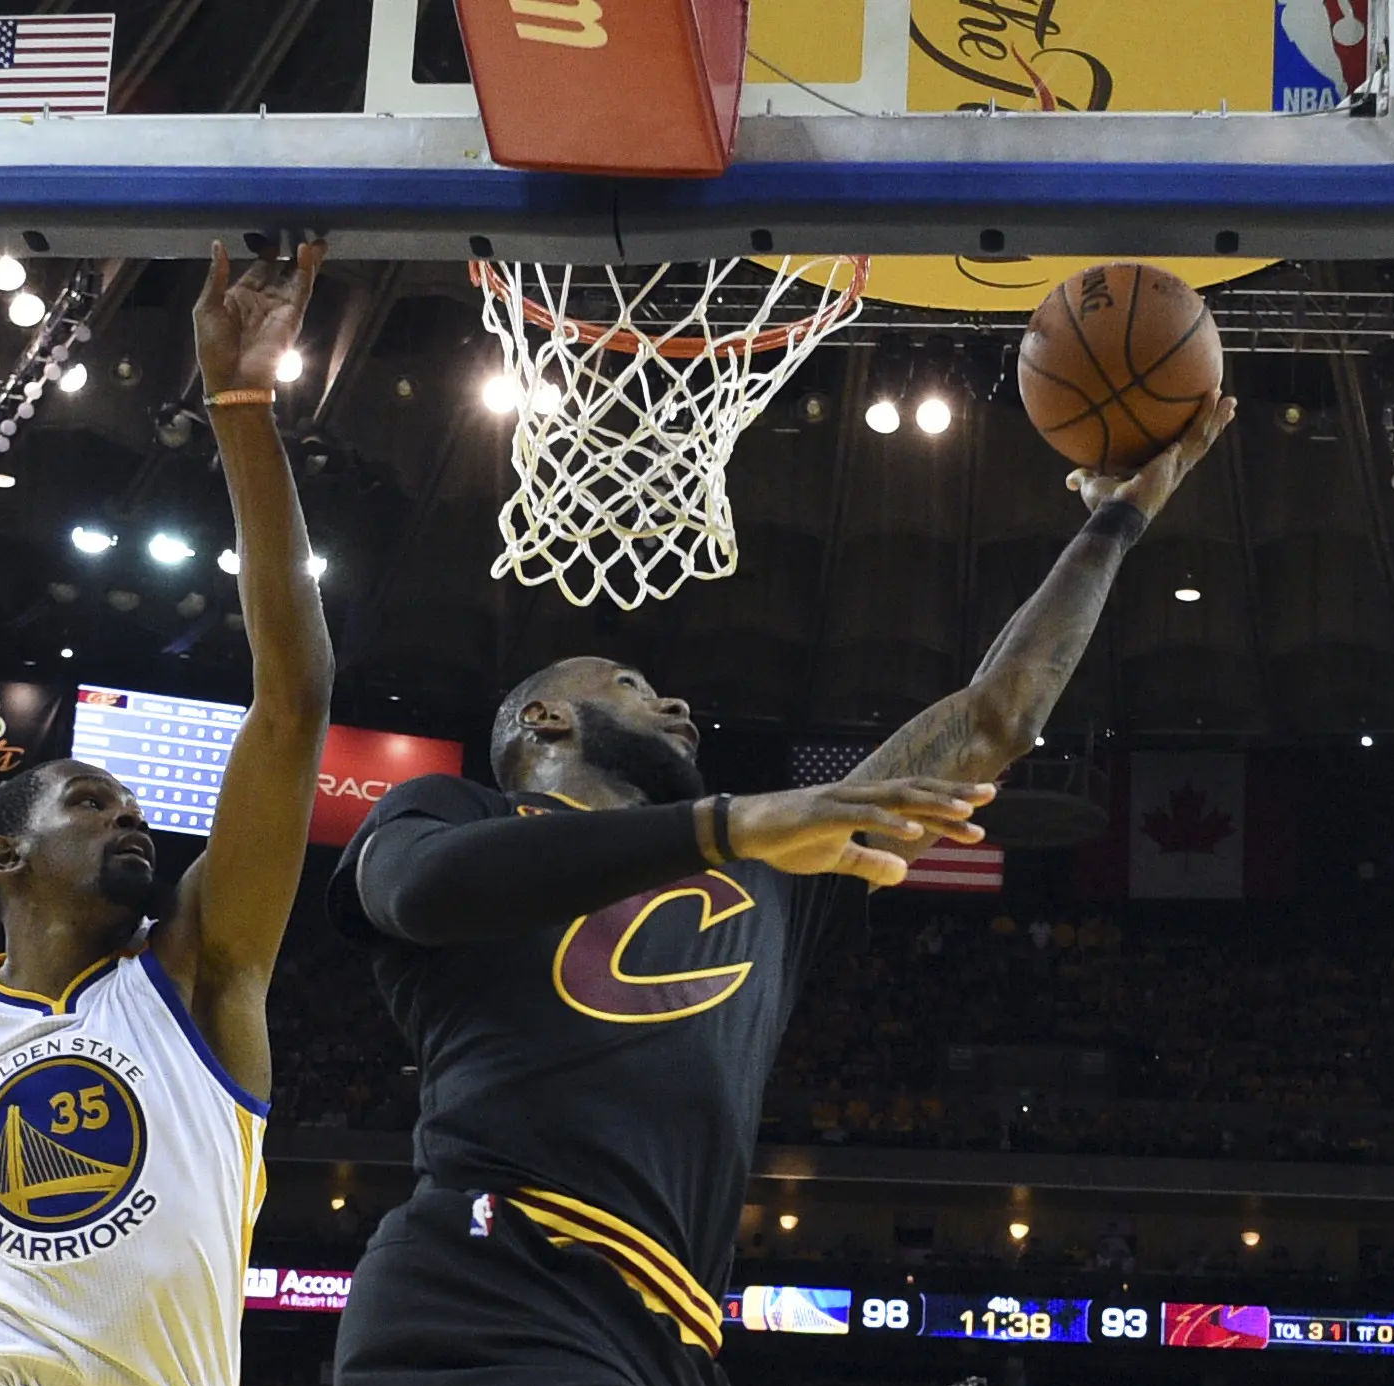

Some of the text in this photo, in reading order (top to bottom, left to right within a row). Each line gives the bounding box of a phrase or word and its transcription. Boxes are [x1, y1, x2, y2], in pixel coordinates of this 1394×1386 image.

[1283, 87, 1335, 112] NBA
[318, 773, 391, 802] RAC
[70, 1037, 144, 1083] STATE
[49, 1084, 110, 1135] 35
[862, 1298, 909, 1329] 98
[987, 1296, 1020, 1313] 4th
[959, 1309, 1052, 1339] 11:38
[1101, 1307, 1147, 1338] 93
[1274, 1322, 1394, 1343] TOL 3 1 TF 0
